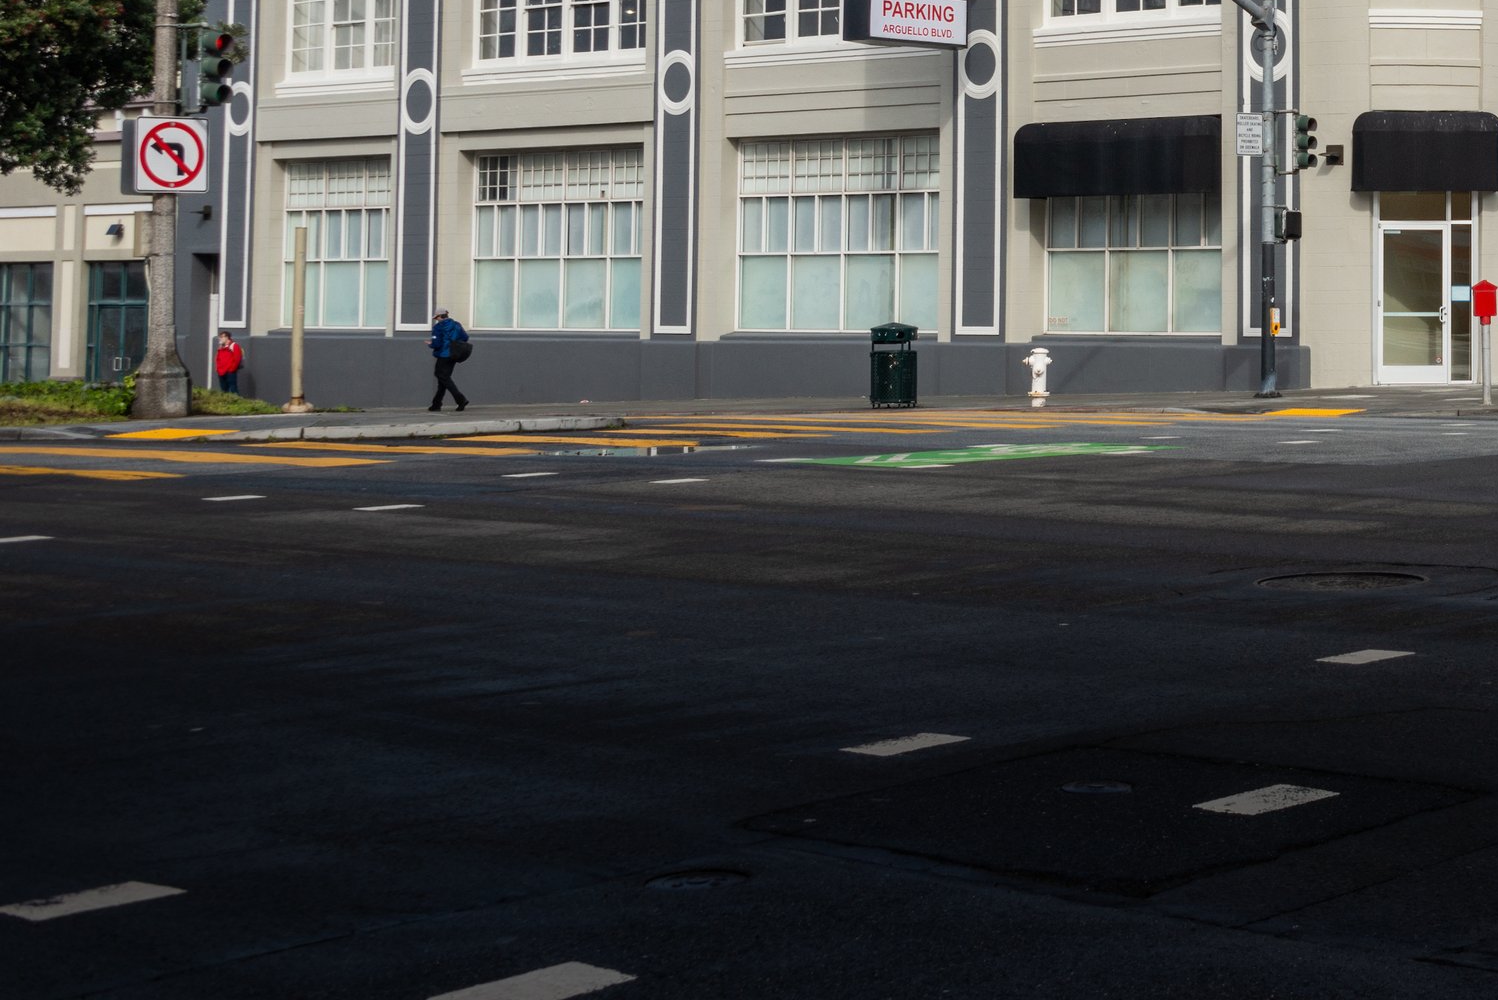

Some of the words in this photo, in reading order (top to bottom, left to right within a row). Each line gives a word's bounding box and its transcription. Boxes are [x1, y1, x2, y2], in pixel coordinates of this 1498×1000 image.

[882, 0, 954, 23] PARKING
[882, 24, 929, 37] ARGUELLO
[931, 28, 955, 38] BLVD.
